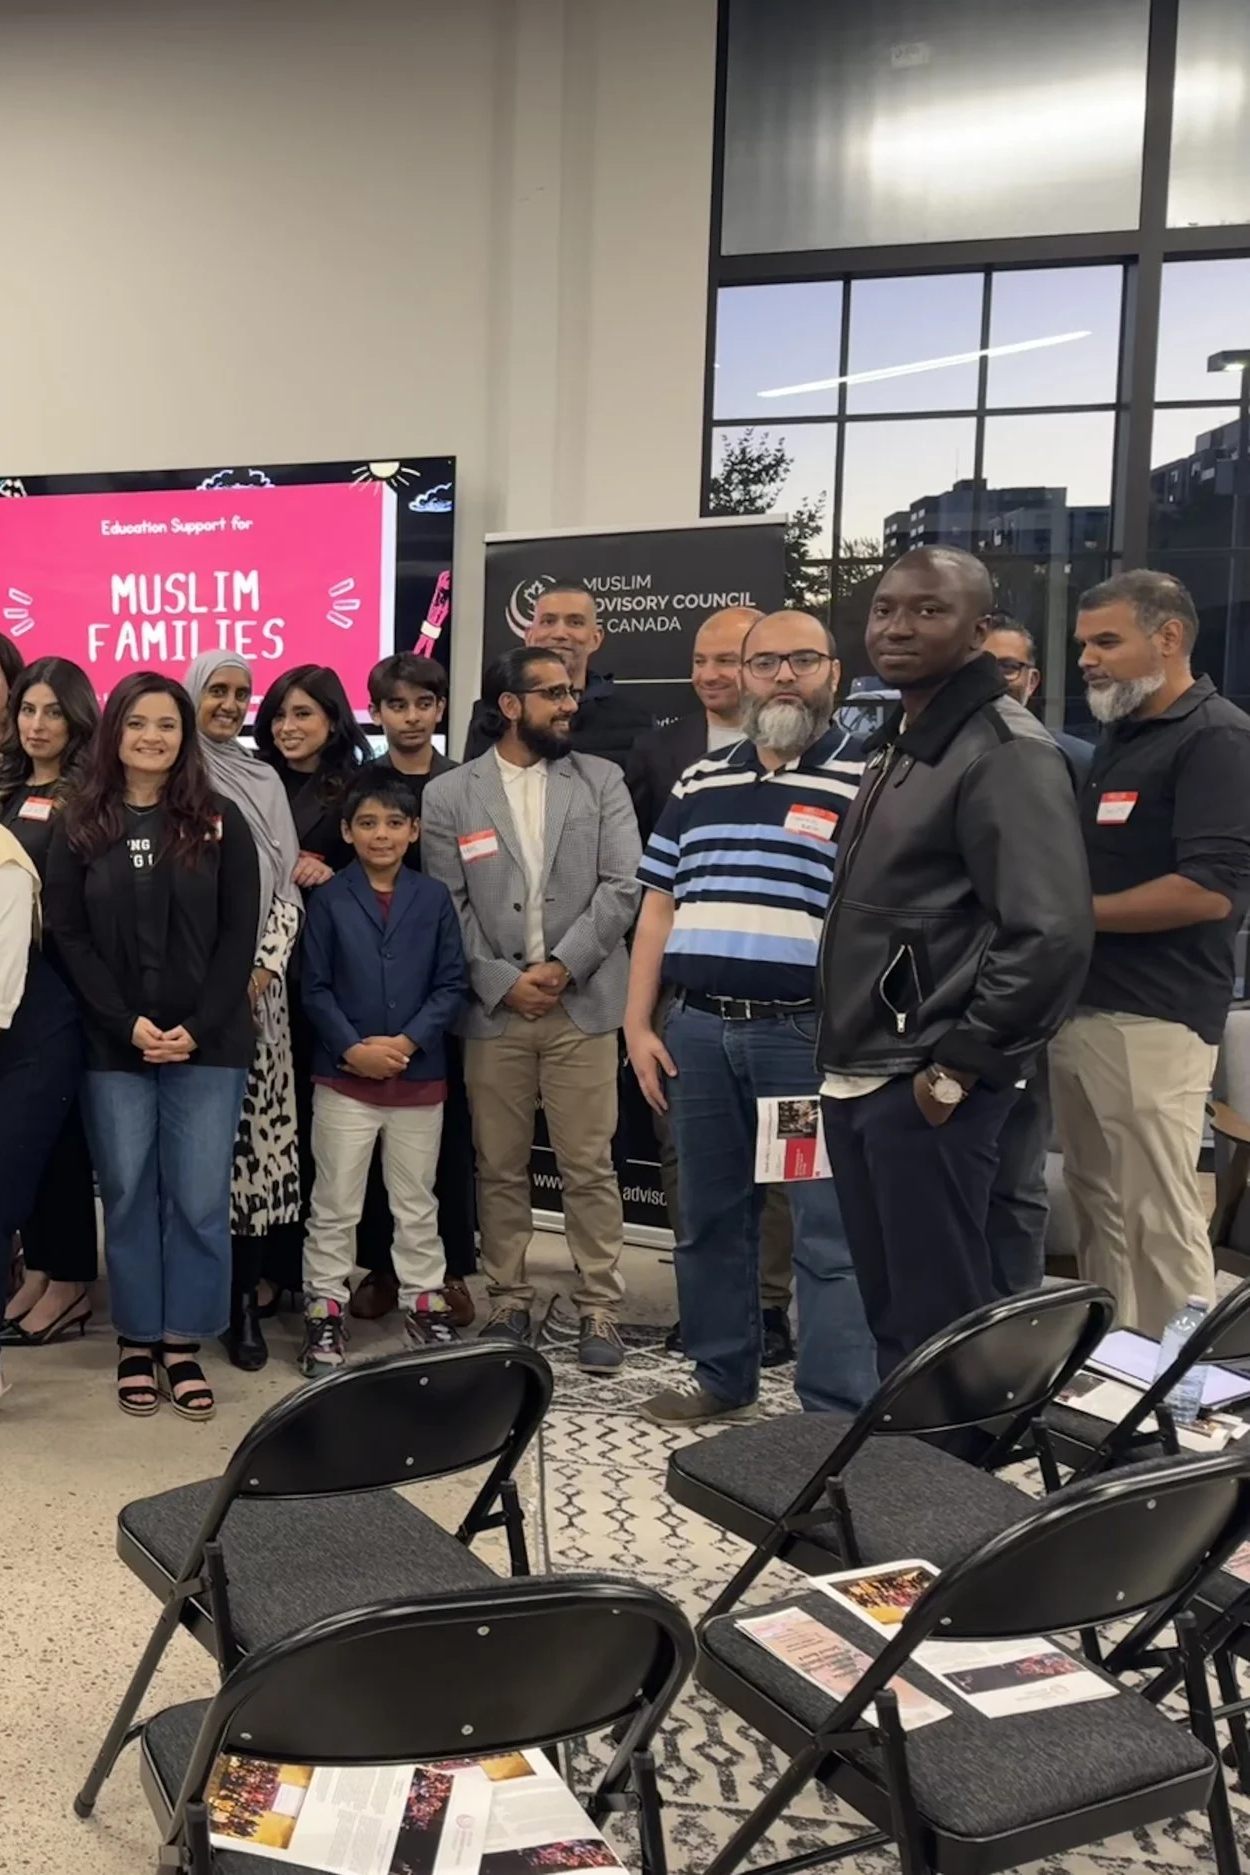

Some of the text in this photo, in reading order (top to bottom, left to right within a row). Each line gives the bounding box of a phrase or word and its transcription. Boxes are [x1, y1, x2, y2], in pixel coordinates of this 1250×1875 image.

[101, 515, 253, 535] Education Support for
[111, 570, 260, 615] MUSLIM
[583, 574, 652, 592] MUSLIM
[596, 592, 756, 613] DVISORY COUNCIL
[607, 616, 681, 633] CANADA
